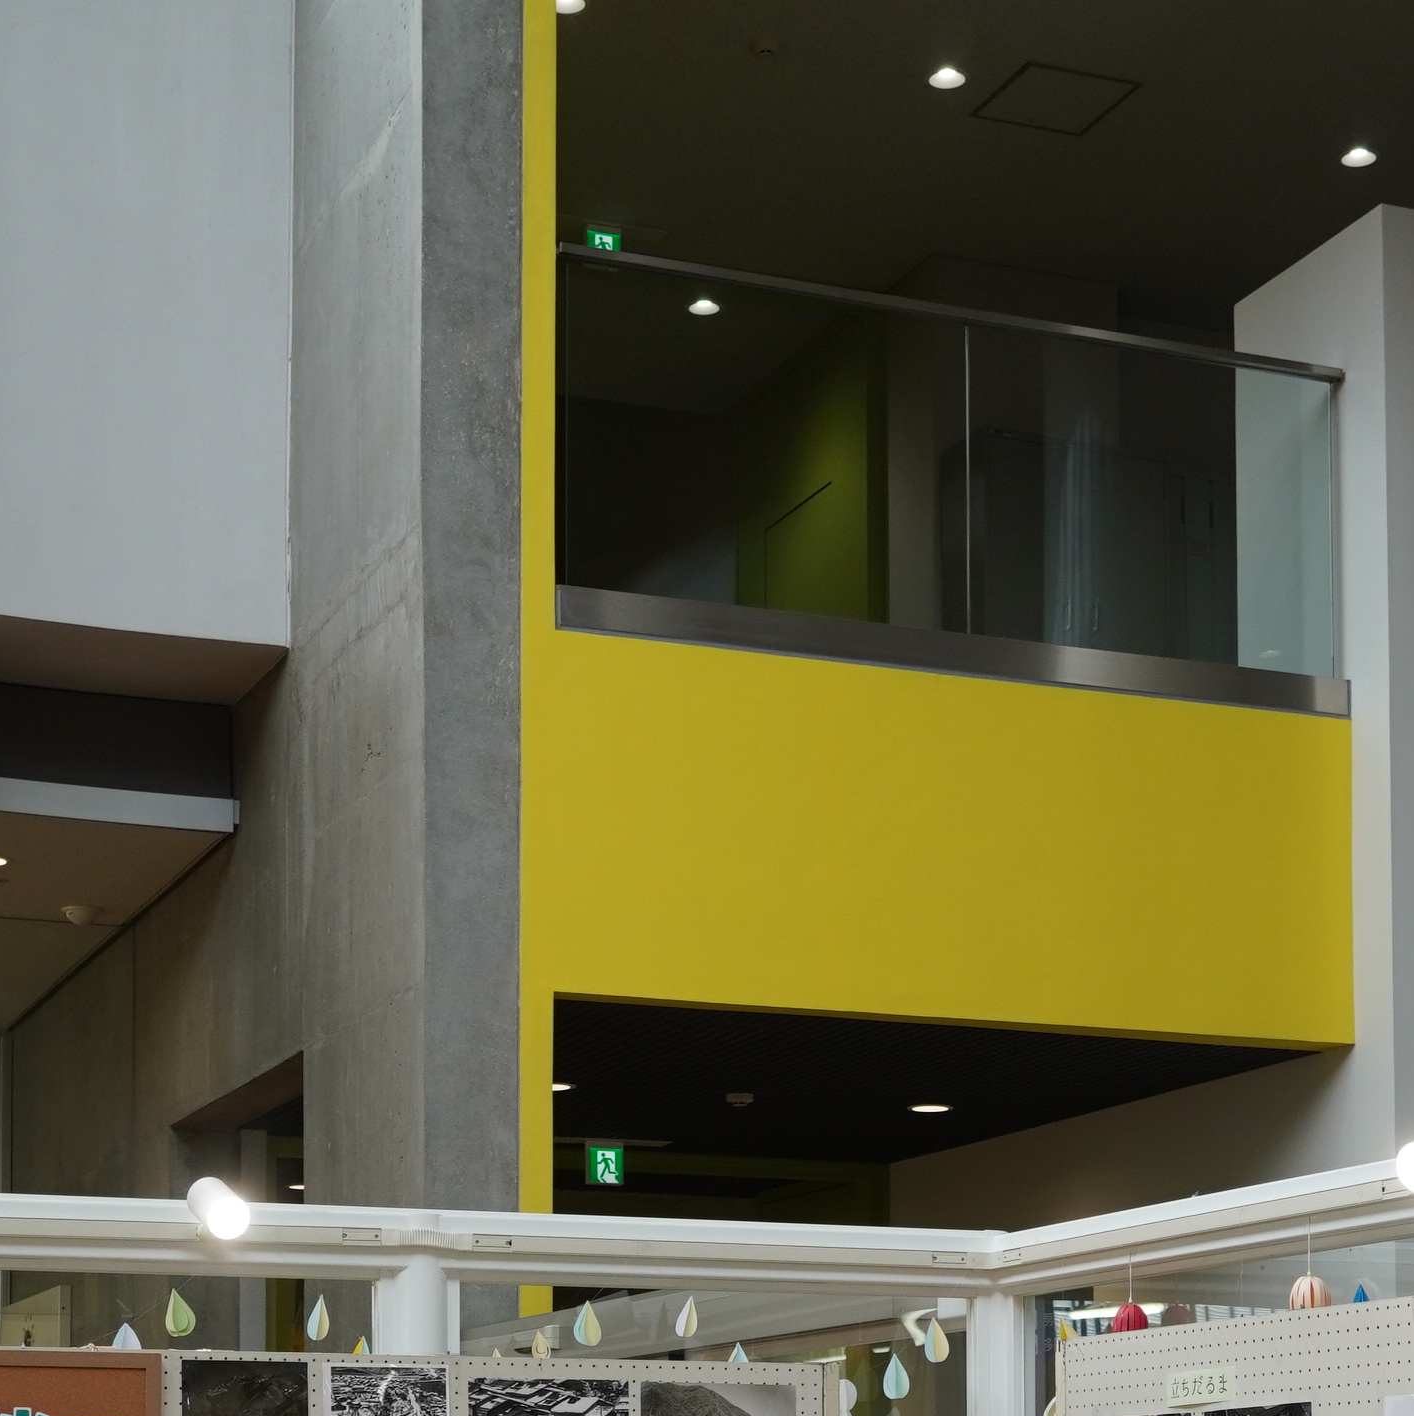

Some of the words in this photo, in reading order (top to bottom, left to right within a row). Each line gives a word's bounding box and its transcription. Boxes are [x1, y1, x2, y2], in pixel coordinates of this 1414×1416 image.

[1170, 1373, 1228, 1399] 立ちだるま
